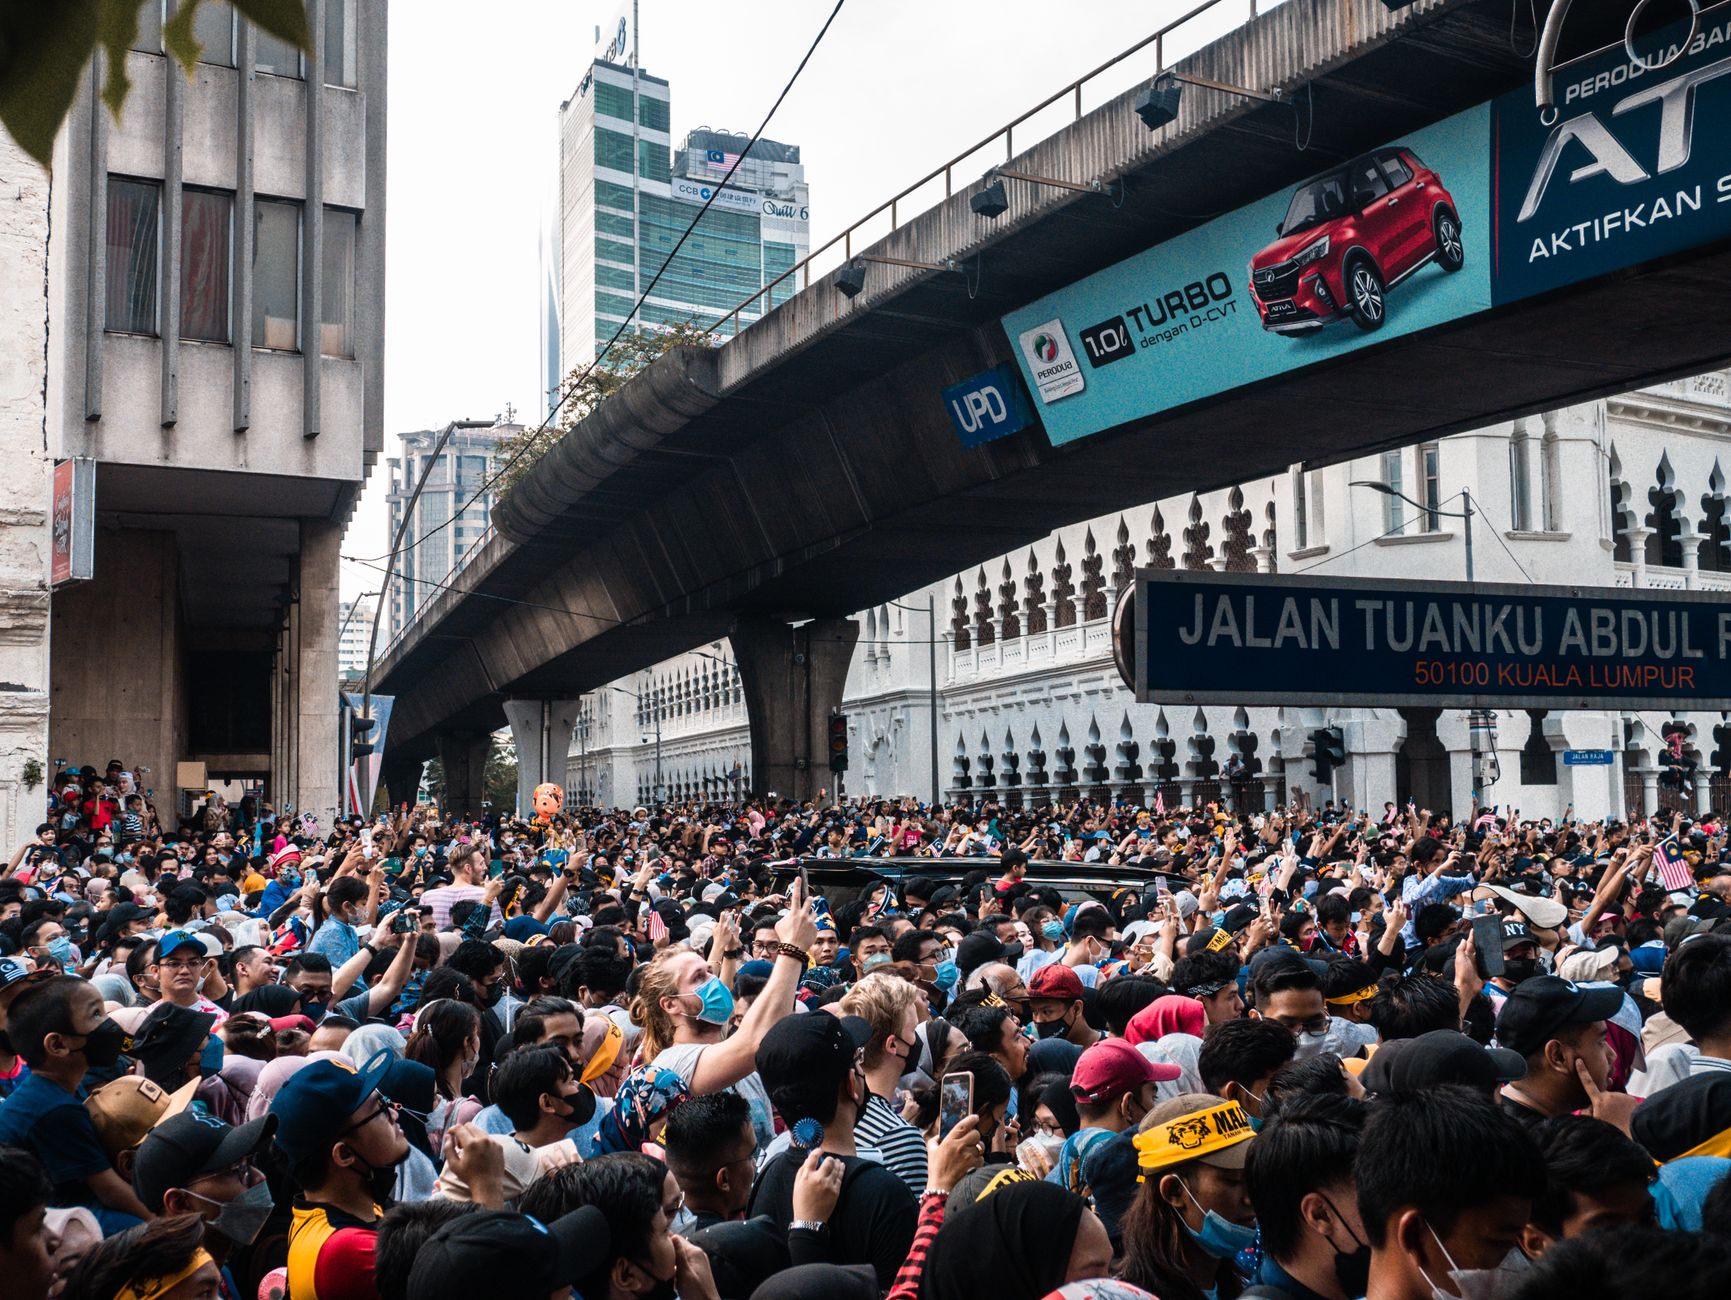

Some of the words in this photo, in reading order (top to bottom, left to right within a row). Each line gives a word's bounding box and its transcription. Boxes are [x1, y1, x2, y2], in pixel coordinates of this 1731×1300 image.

[1566, 43, 1679, 104] PERODUA
[679, 184, 698, 196] CCB
[763, 200, 797, 218] Quill
[800, 206, 809, 220] 6
[1529, 185, 1701, 263] AKTIFKAN
[1126, 272, 1233, 332] TURBO
[1140, 323, 1189, 349] dengan
[1190, 300, 1237, 329] D-CVT
[952, 386, 1007, 432] UPD
[1178, 593, 1340, 650] JALAN
[1356, 599, 1543, 655] TUANKU
[1558, 607, 1703, 659] ABDUL
[1415, 661, 1489, 685] 50100
[1499, 663, 1583, 687] KUALA
[1590, 665, 1695, 689] LUMPUR
[1504, 923, 1524, 936] NY
